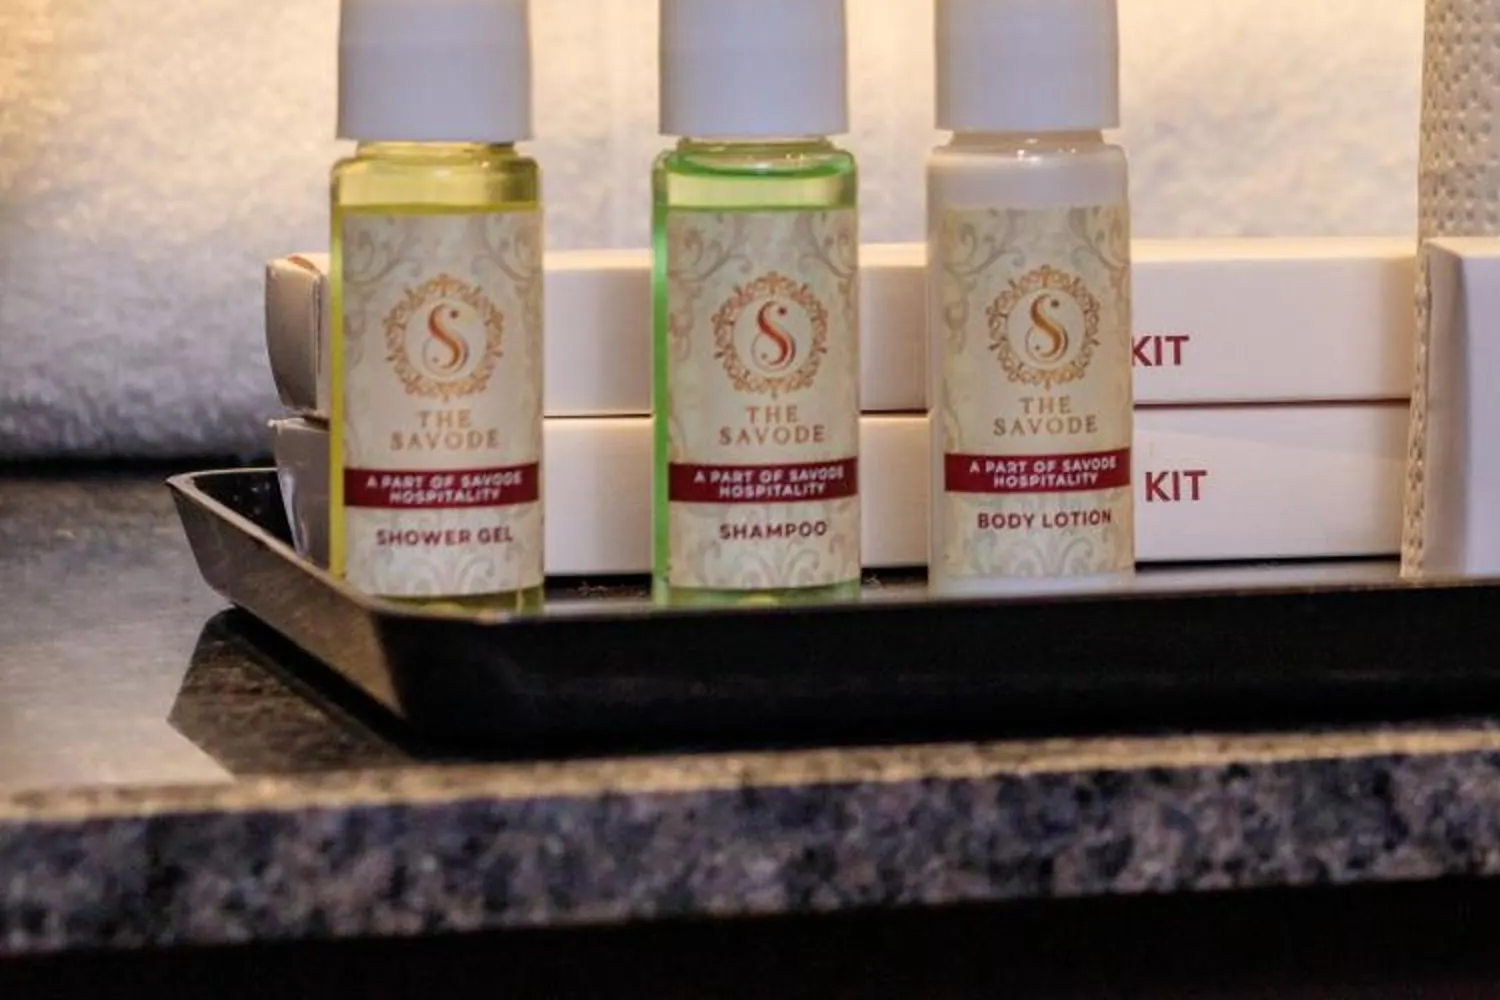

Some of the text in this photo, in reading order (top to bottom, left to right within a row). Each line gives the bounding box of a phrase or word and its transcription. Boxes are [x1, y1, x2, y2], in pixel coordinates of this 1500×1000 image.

[1131, 335, 1190, 367] KIT
[746, 405, 798, 424] THE
[1019, 396, 1072, 414] THE
[417, 410, 472, 428] THE
[993, 415, 1098, 437] SAVODE
[390, 429, 499, 450] SAVODE
[719, 425, 825, 445] SAVODE
[969, 456, 1117, 473] A PART OF SAVODE
[366, 471, 523, 488] A PART OF SAVODE
[694, 466, 844, 483] A PART OF SAVODE
[994, 472, 1099, 488] HOSPITALITY
[719, 483, 826, 498] HOSPITALITY
[1145, 470, 1207, 501] KIT
[389, 488, 501, 503] HOSPITALITY
[978, 509, 1112, 529] BODY LOTION
[376, 526, 514, 546] SHOWER GEL
[719, 521, 828, 540] SHAMPOO
